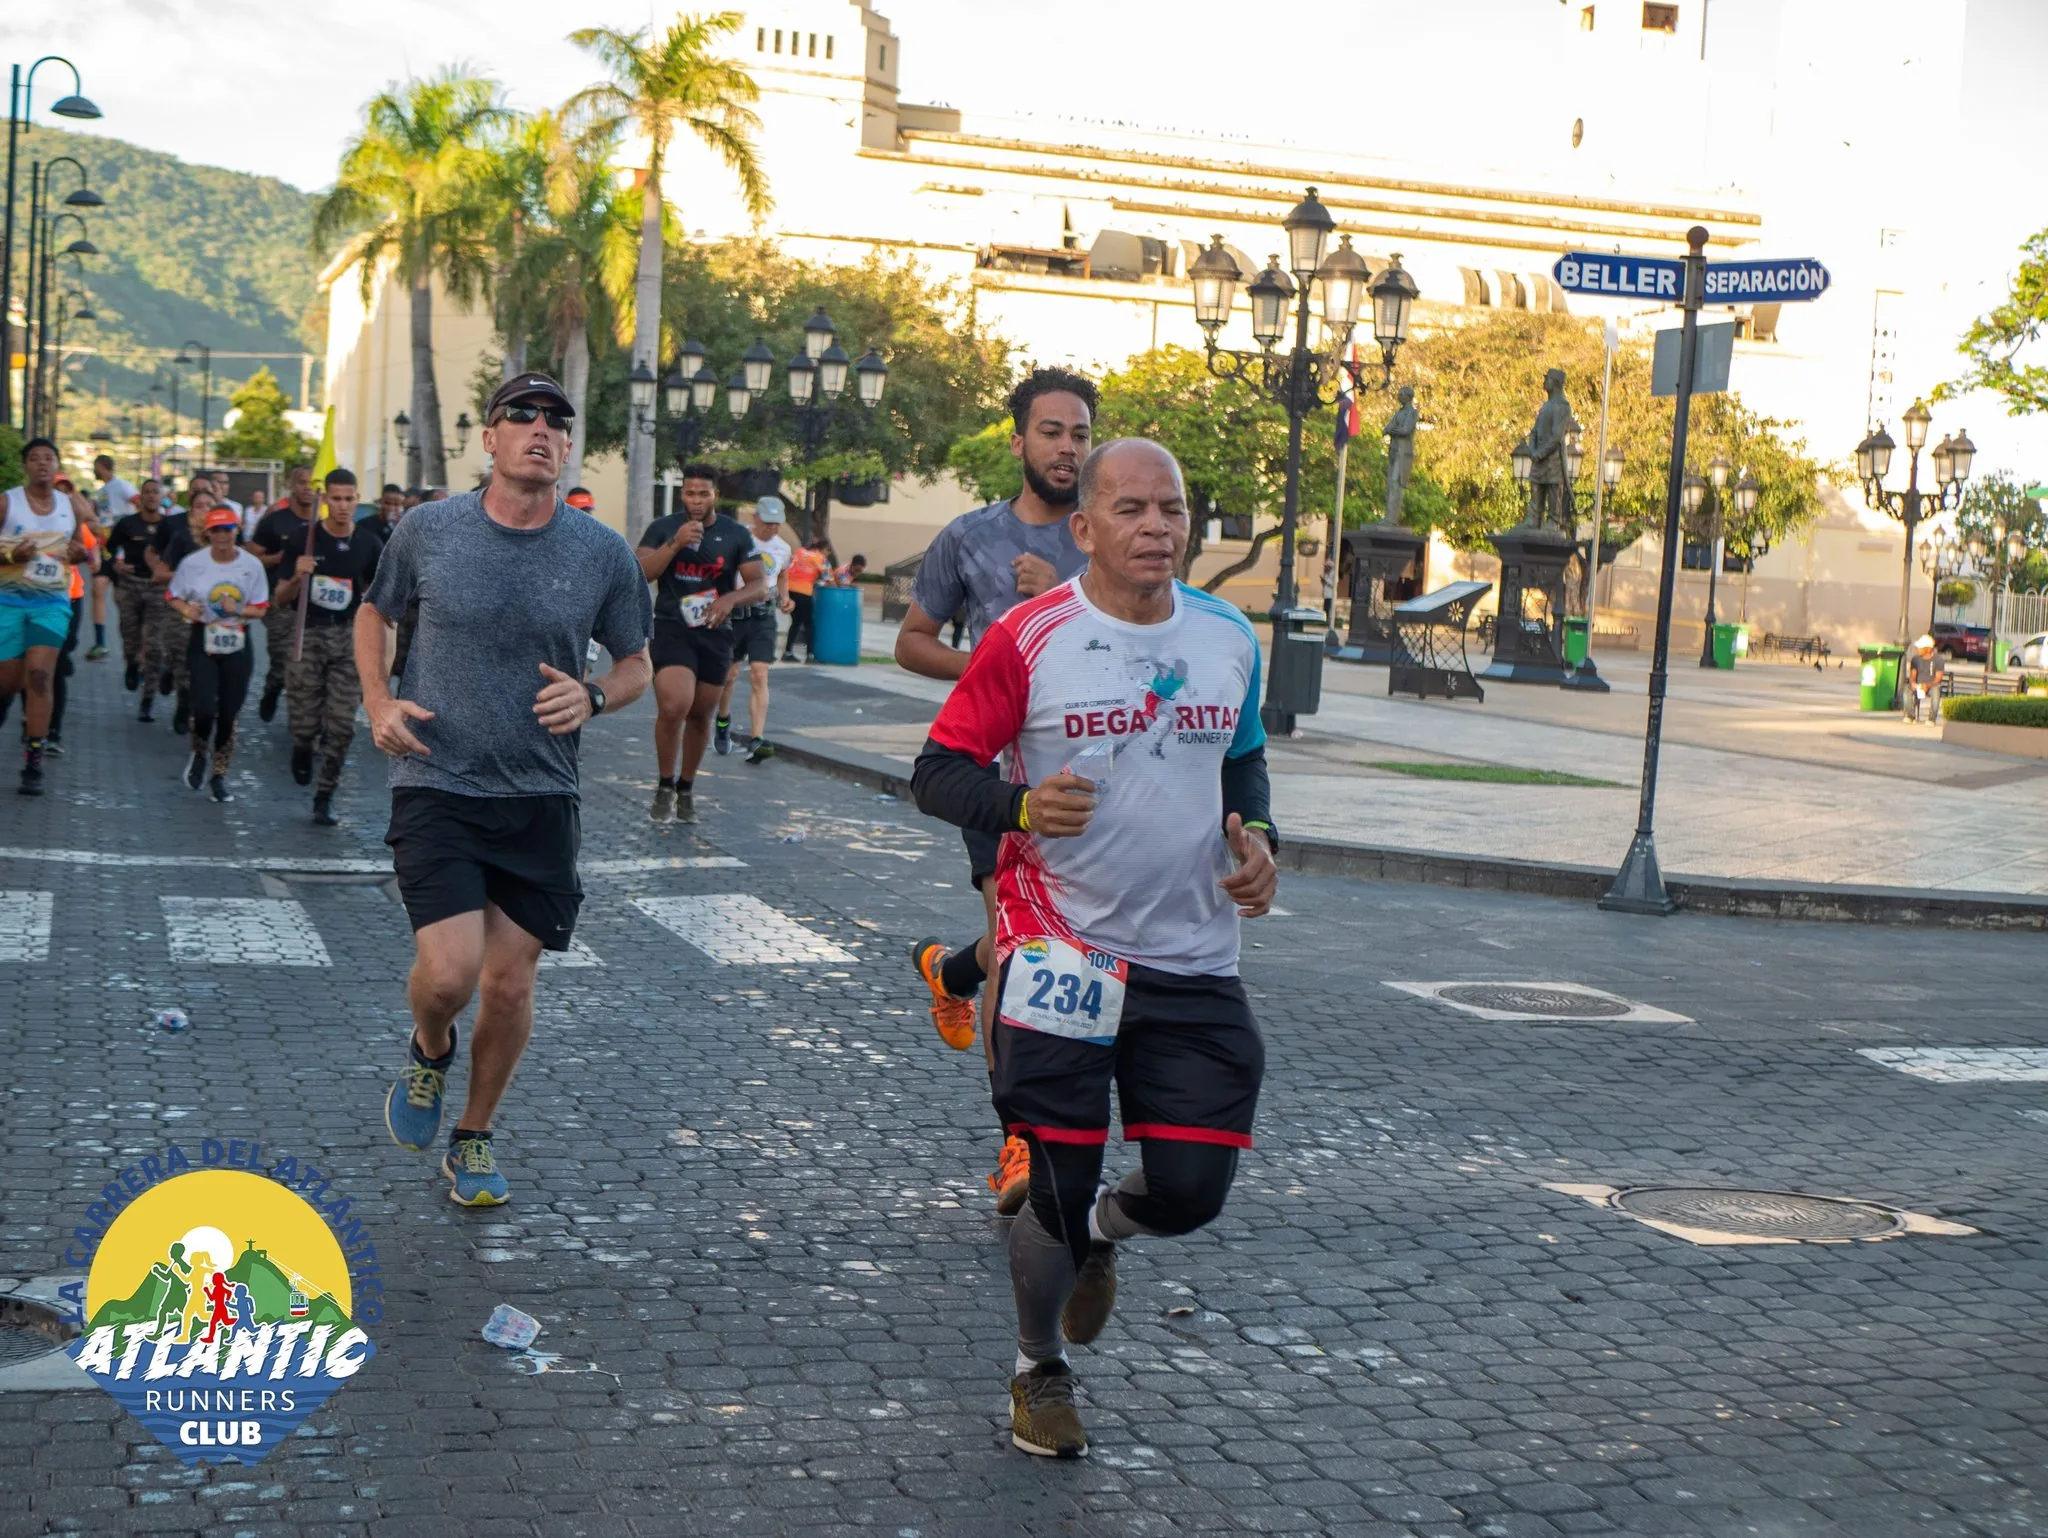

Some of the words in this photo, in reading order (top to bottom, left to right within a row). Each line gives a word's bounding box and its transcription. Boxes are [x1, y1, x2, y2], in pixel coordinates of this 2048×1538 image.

[1560, 261, 1676, 295] BELLER
[319, 588, 345, 604] 288
[214, 635, 237, 647] 492
[1088, 951, 1119, 973] 10K
[1028, 969, 1102, 1020] 234
